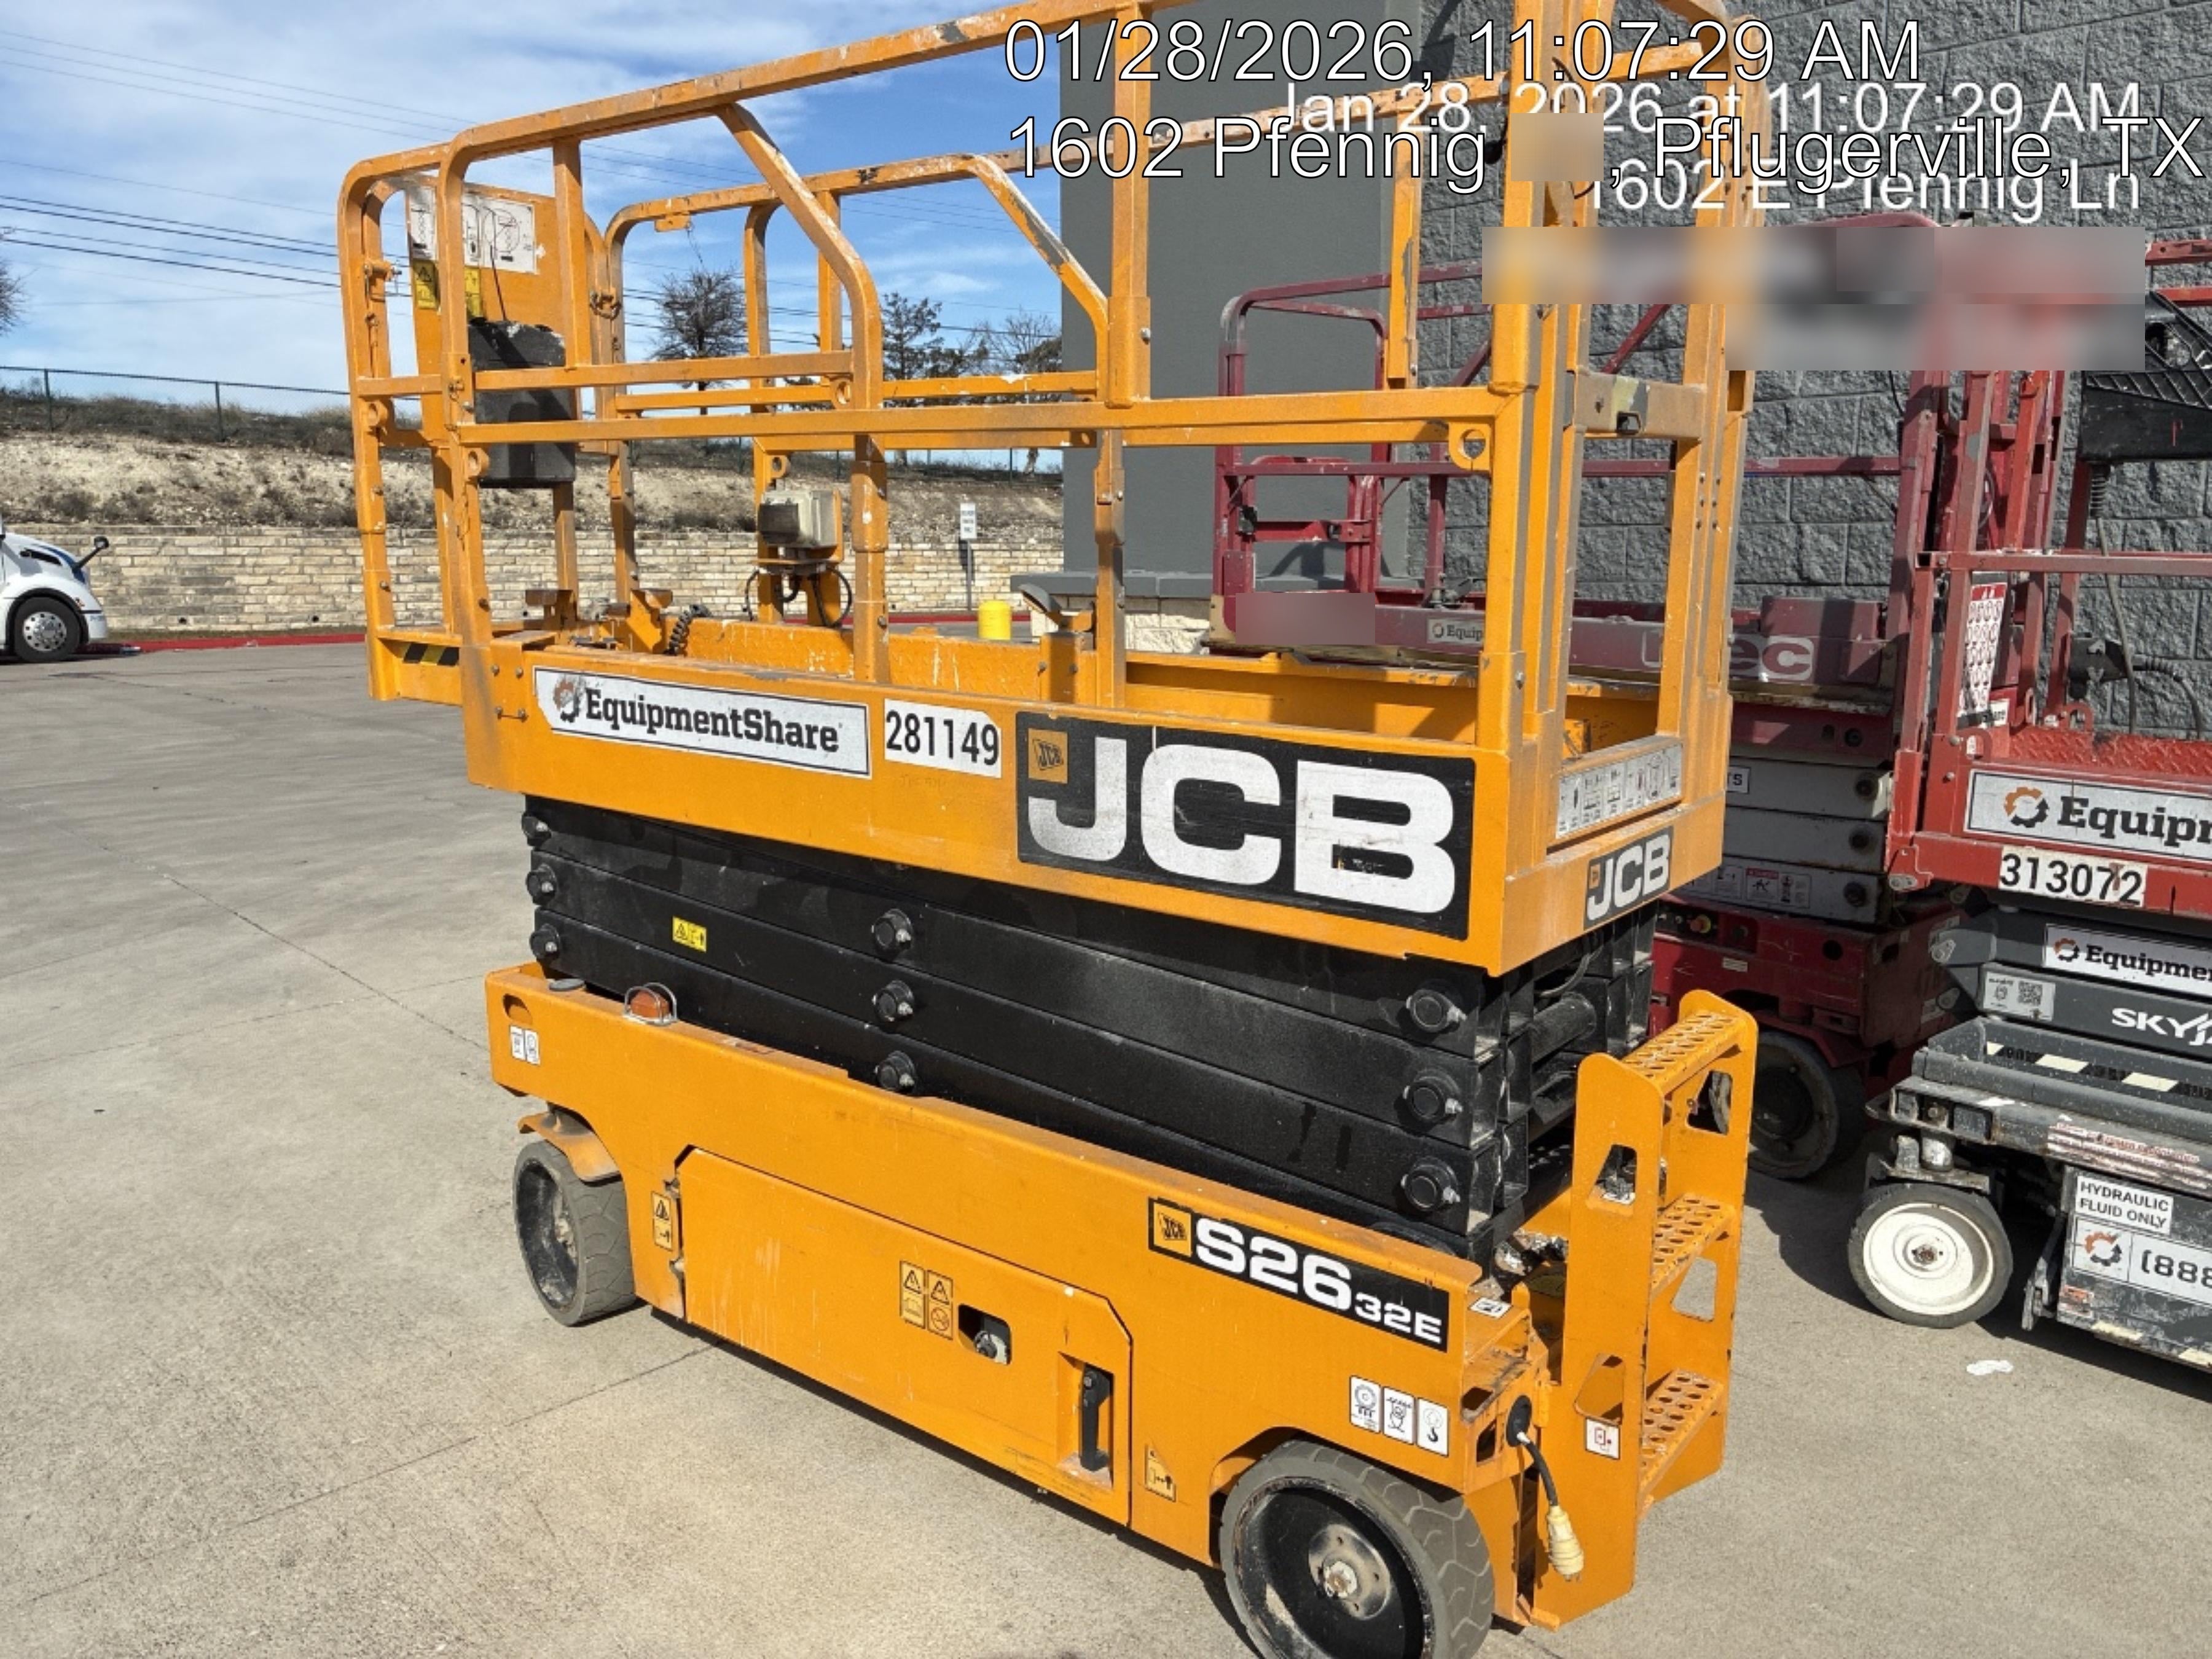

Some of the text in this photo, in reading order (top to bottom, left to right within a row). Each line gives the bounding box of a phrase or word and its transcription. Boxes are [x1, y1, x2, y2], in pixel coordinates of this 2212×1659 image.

[585, 688, 840, 753] EquipmentShare
[885, 709, 999, 766] 281149
[1027, 736, 1456, 914] JCB
[1586, 834, 1671, 920] JCB
[2000, 853, 2143, 906] 313072
[2085, 944, 2212, 981] Equipme
[2111, 1007, 2212, 1046] SKYJ
[2080, 1181, 2169, 1212] HYDRAULIC
[2080, 1198, 2167, 1229] FLUID ONLY
[1196, 1217, 1442, 1344] S26 32E
